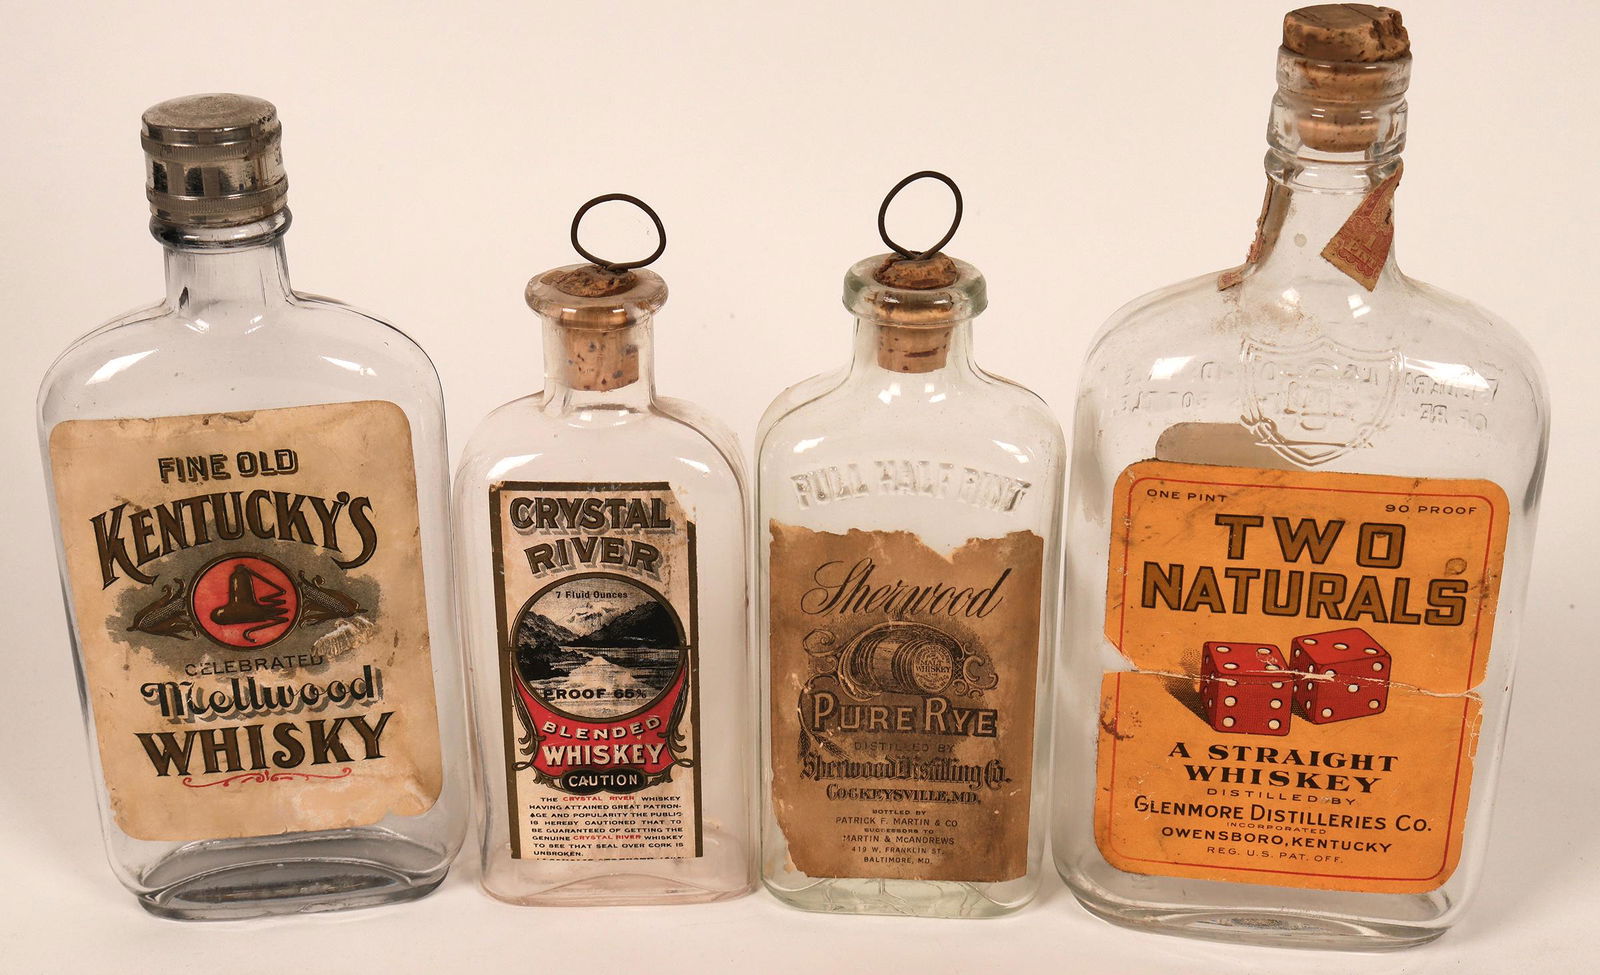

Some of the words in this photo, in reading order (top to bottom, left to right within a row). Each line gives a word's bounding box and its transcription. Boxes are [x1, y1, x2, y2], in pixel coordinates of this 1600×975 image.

[158, 453, 232, 484] FINE
[236, 448, 299, 478] OLD
[1146, 488, 1181, 500] ONE
[1187, 491, 1228, 503] PINT
[1385, 504, 1411, 514] 90
[1417, 504, 1478, 516] PROOF
[509, 496, 674, 535] CRYSTAL
[88, 489, 378, 590] KENTUCKY'S
[1214, 512, 1407, 570] TWO
[523, 536, 662, 579] RIVER
[555, 591, 561, 599] 7
[565, 590, 590, 599] Fluid
[593, 590, 628, 599] Ounces
[800, 556, 1013, 619] Sherwood
[1140, 560, 1469, 627] NATURALS
[185, 653, 325, 677] CELEBRATED
[140, 664, 383, 722] Mellwood
[543, 688, 607, 700] PROOF
[812, 691, 915, 734] PURE
[922, 694, 999, 738] RYE
[542, 716, 662, 740] BLENDED
[134, 710, 397, 777] WHISKY
[541, 743, 666, 766] WHISKEY
[937, 743, 955, 753] BY
[1168, 741, 1193, 759] A
[1207, 743, 1400, 772] STRAIGHT
[568, 774, 638, 787] CAUTION
[799, 752, 898, 781] Sherwood
[983, 758, 1013, 791] Co.
[1183, 763, 1384, 794] WHISKEY
[1206, 787, 1318, 803] DISTILLED
[1331, 797, 1357, 806] BY
[835, 816, 876, 824] PATRICK
[880, 817, 889, 825] F.
[893, 817, 930, 826] MARTIN
[1226, 821, 1327, 835] INCORPORATED
[842, 834, 880, 842] MARTIN
[884, 835, 892, 843] &
[885, 846, 927, 854] FRANKLIN
[1291, 836, 1393, 853] KENTUCKY
[863, 856, 914, 865] BALTIMORE,
[917, 857, 933, 865] MD.
[1206, 846, 1241, 856] REG.
[1246, 849, 1274, 858] U.S.
[1279, 851, 1309, 862] PAT.
[1313, 854, 1344, 864] OFF.
